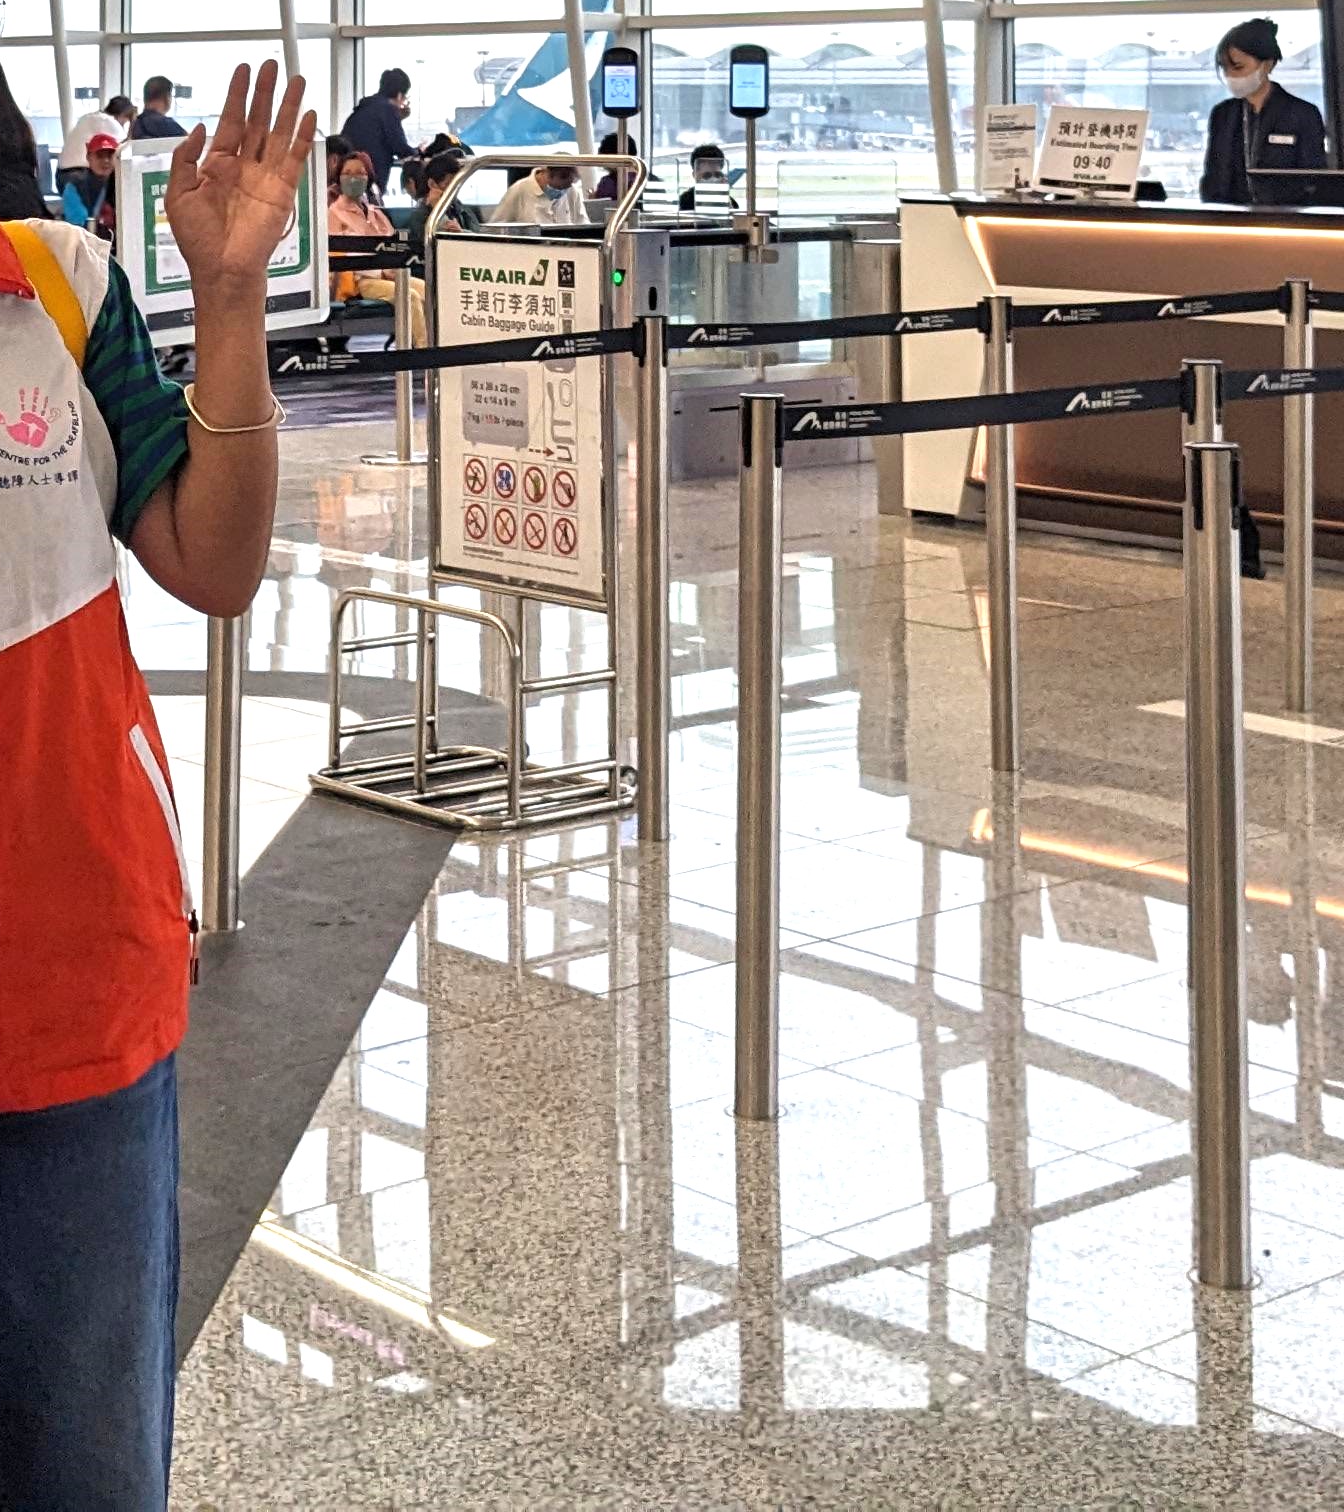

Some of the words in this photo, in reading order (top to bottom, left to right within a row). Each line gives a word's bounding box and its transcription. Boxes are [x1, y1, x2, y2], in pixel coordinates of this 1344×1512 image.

[1073, 155, 1112, 170] 09:40
[459, 266, 494, 283] EVA
[495, 269, 526, 285] AIR
[460, 289, 556, 317] 手提行李須知
[460, 313, 486, 327] Cabin
[488, 315, 527, 333] Baggage
[528, 319, 555, 333] Guide
[32, 455, 51, 466] FOR
[52, 444, 68, 460] THE
[65, 400, 80, 447] DEAFBLIND
